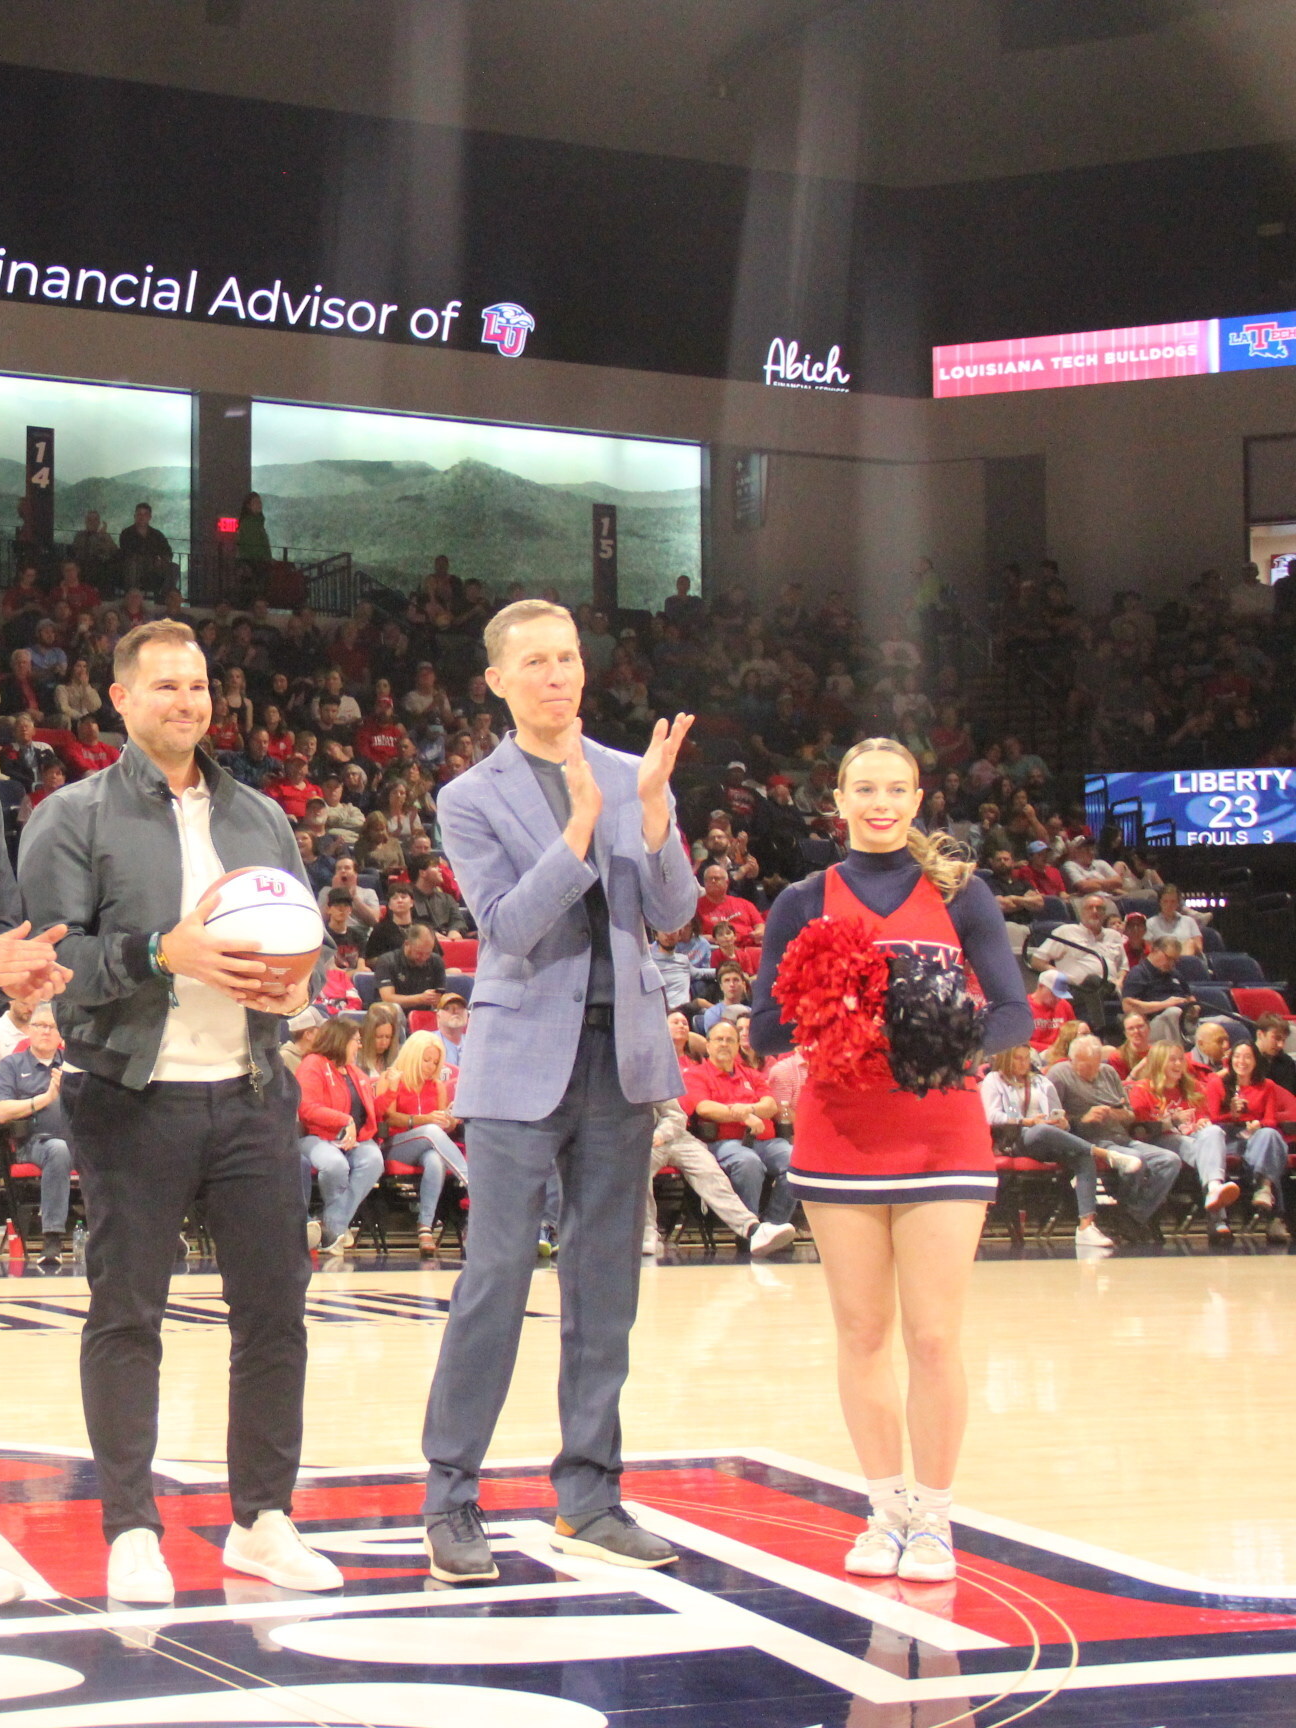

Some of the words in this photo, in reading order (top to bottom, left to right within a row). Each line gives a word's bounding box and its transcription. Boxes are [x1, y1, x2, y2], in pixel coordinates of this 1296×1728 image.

[207, 276, 398, 335] Advisor
[409, 300, 461, 341] of
[763, 337, 850, 386] Abich
[938, 358, 1045, 381] LOUISIANA
[1051, 354, 1099, 370] TECH
[1104, 343, 1199, 365] BULLDOGS
[1173, 769, 1292, 794] LIBERTY
[1208, 795, 1259, 828] 23
[1187, 830, 1249, 847] FOULS
[1262, 829, 1274, 844] 3
